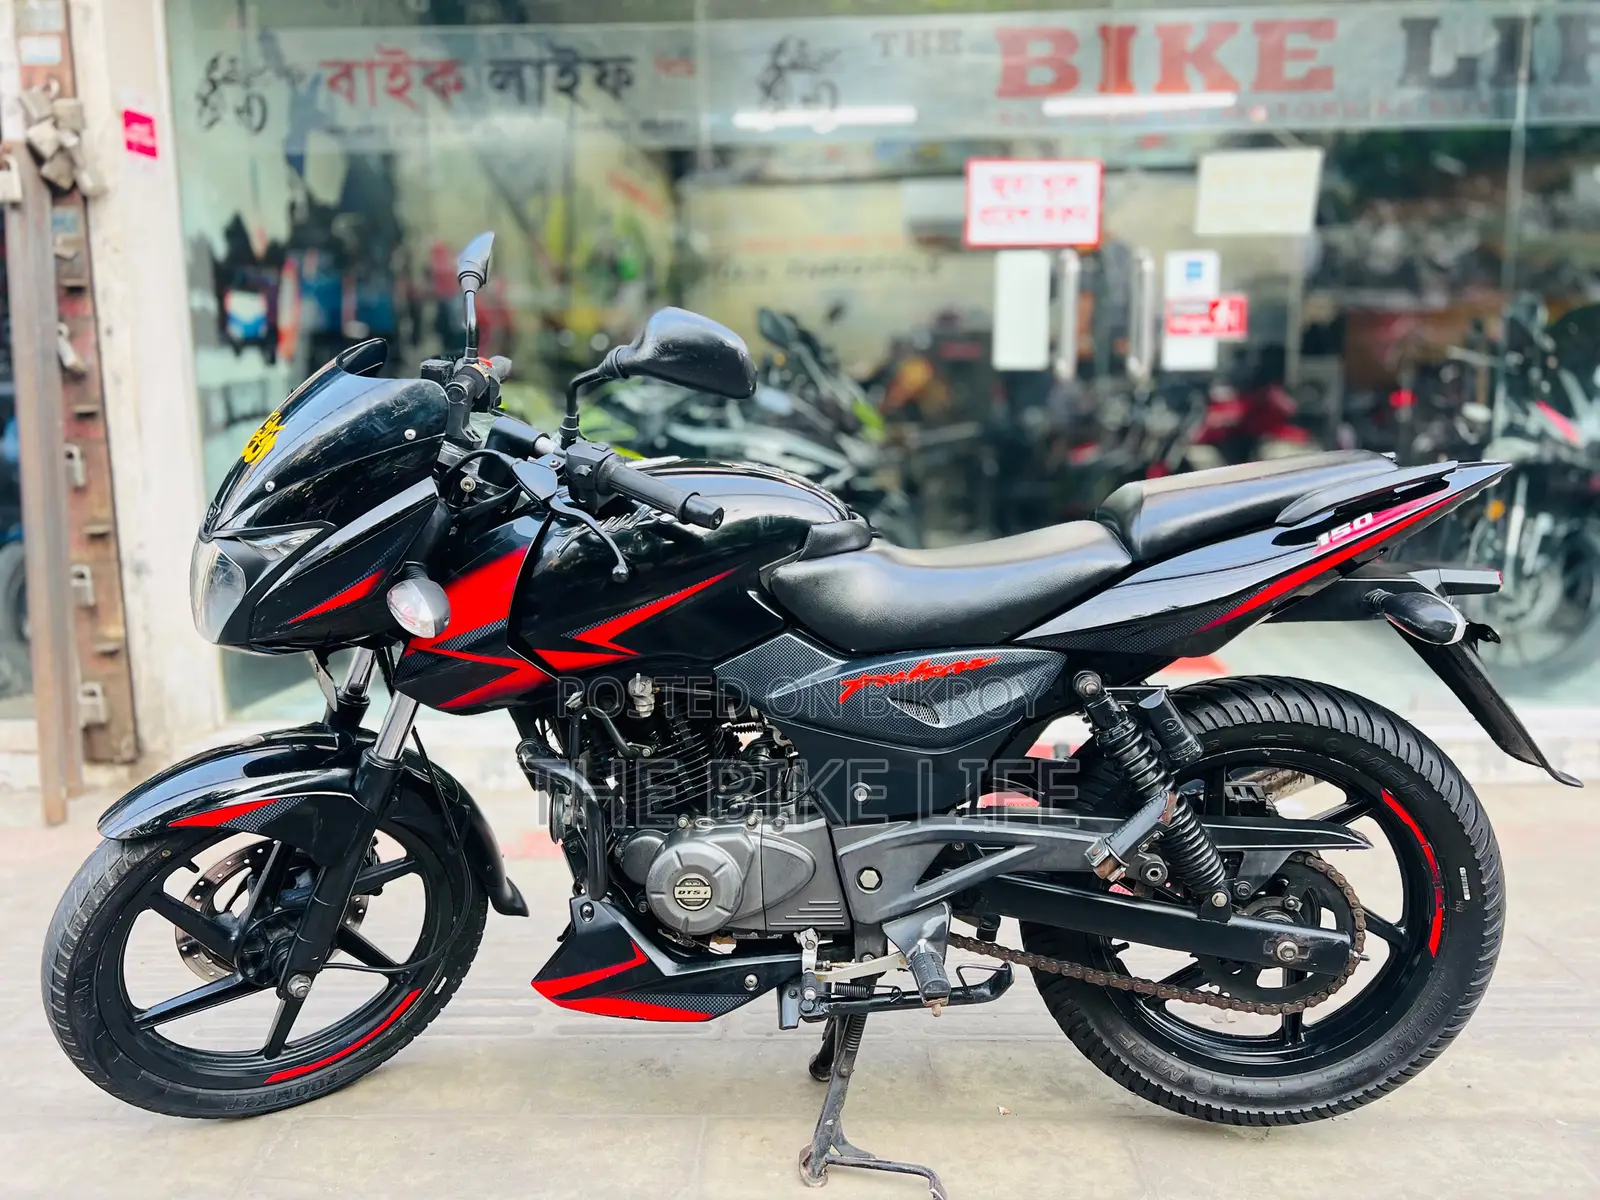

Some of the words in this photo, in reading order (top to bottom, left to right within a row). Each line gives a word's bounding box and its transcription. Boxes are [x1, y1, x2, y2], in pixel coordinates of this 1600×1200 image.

[319, 43, 464, 112] বাইক
[487, 42, 637, 108] লাইফ
[871, 27, 962, 58] THE
[995, 20, 1336, 100] BIKE
[1316, 512, 1373, 547] 150
[1113, 1031, 1186, 1084] MRF
